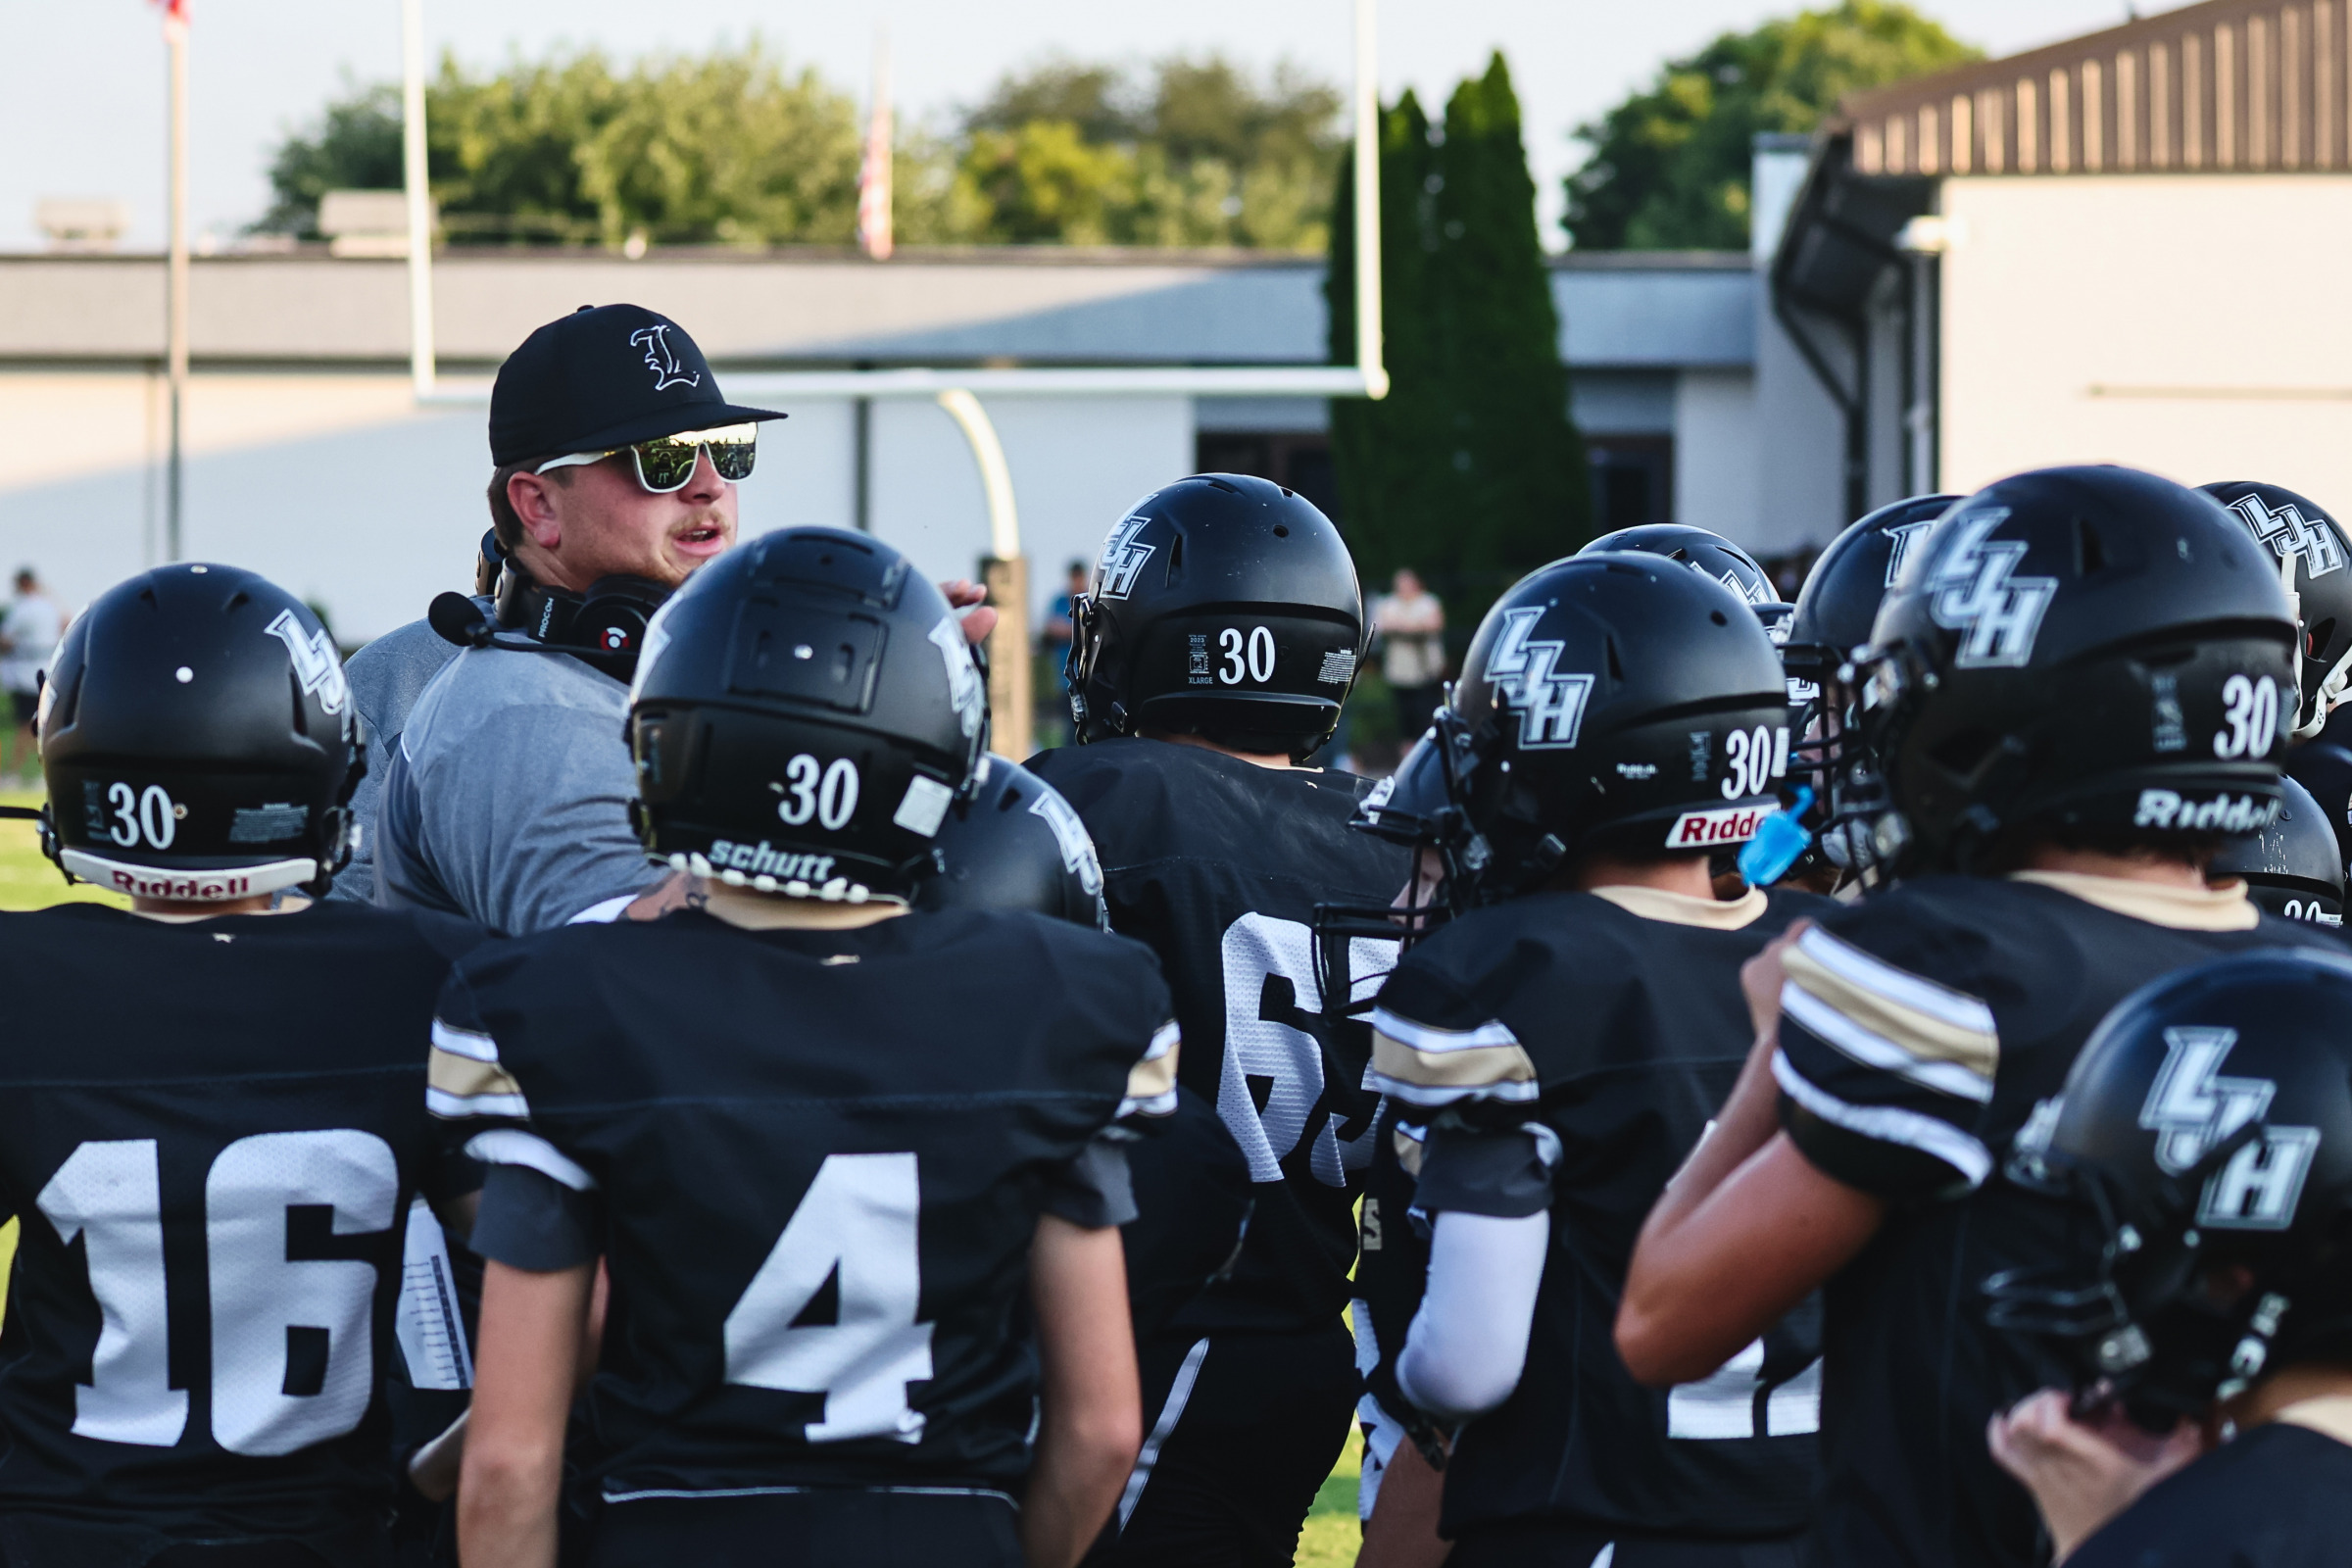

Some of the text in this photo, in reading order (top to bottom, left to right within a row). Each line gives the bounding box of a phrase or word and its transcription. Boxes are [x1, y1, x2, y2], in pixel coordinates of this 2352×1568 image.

[630, 324, 700, 390] L
[2226, 493, 2342, 579] LJH
[538, 596, 555, 638] PROCOM
[1924, 506, 2059, 669] LJH
[264, 608, 353, 743] LJ
[1188, 676, 1213, 685] XLARGE
[1219, 625, 1276, 685] 30
[1483, 606, 1595, 751] LJH
[2213, 673, 2278, 760] 30
[778, 753, 859, 830] 30
[1721, 724, 1771, 801] 30
[108, 782, 175, 850] 30
[112, 870, 249, 899] Riddell
[708, 840, 835, 882] schutt
[2138, 1026, 2322, 1231] LJH
[36, 1128, 398, 1456] 16
[723, 1152, 936, 1445] 4
